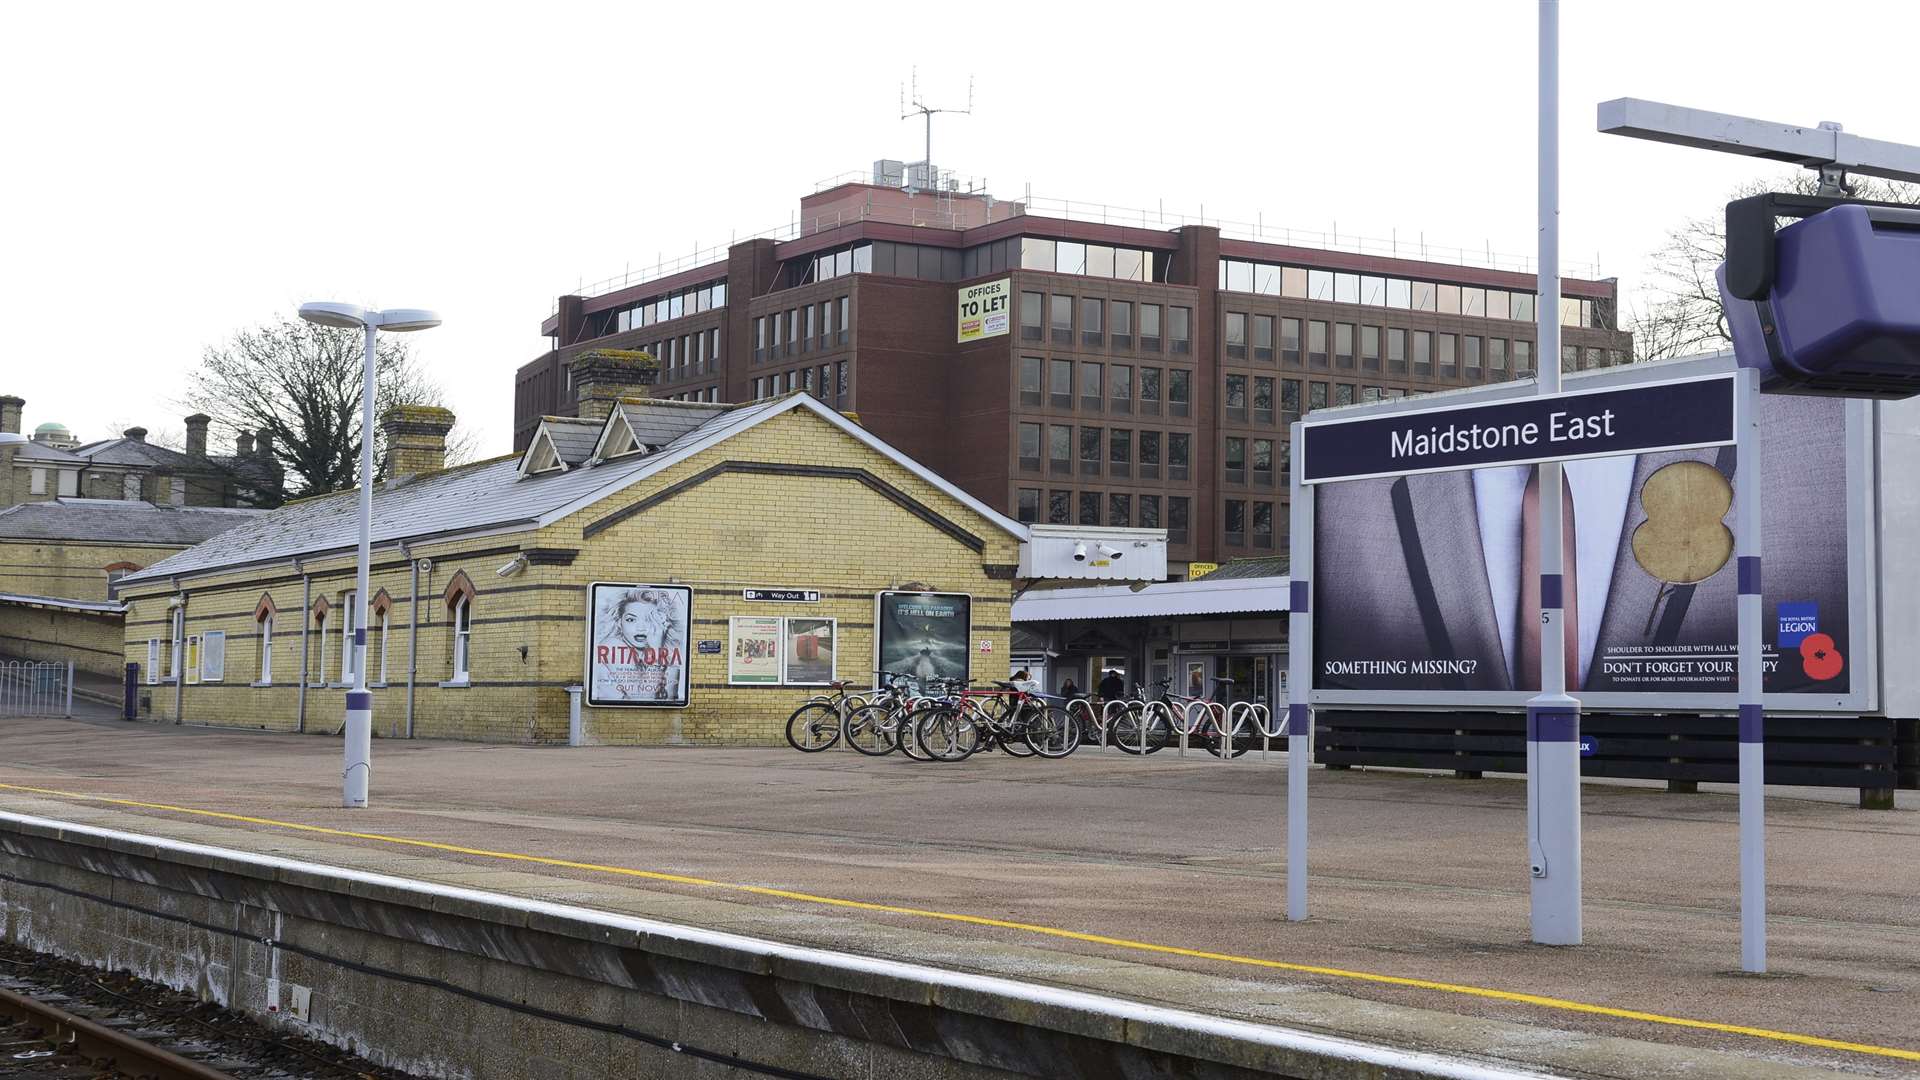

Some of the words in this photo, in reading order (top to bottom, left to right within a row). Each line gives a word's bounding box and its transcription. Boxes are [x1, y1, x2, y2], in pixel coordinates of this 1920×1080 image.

[968, 283, 1001, 299] OFFICES
[961, 301, 979, 317] TO
[983, 295, 1008, 313] LET
[1391, 422, 1539, 458] Maidstone
[1550, 409, 1615, 442] East
[771, 592, 785, 600] Way
[1541, 611, 1550, 624] 5
[1780, 622, 1816, 633] LEGION
[597, 645, 639, 665] RITA
[643, 646, 682, 666] ORA
[1607, 645, 1643, 654] SHOULDER
[1644, 645, 1654, 653] TO
[1655, 645, 1692, 653] SHOULDER
[1693, 644, 1714, 652] WITH
[1715, 644, 1729, 652] ALL
[1325, 660, 1407, 675] SOMETHING
[1411, 659, 1477, 675] MISSING?
[1603, 662, 1642, 673] DON'T
[1645, 661, 1694, 673] FORGET
[1697, 661, 1734, 673] YOUR
